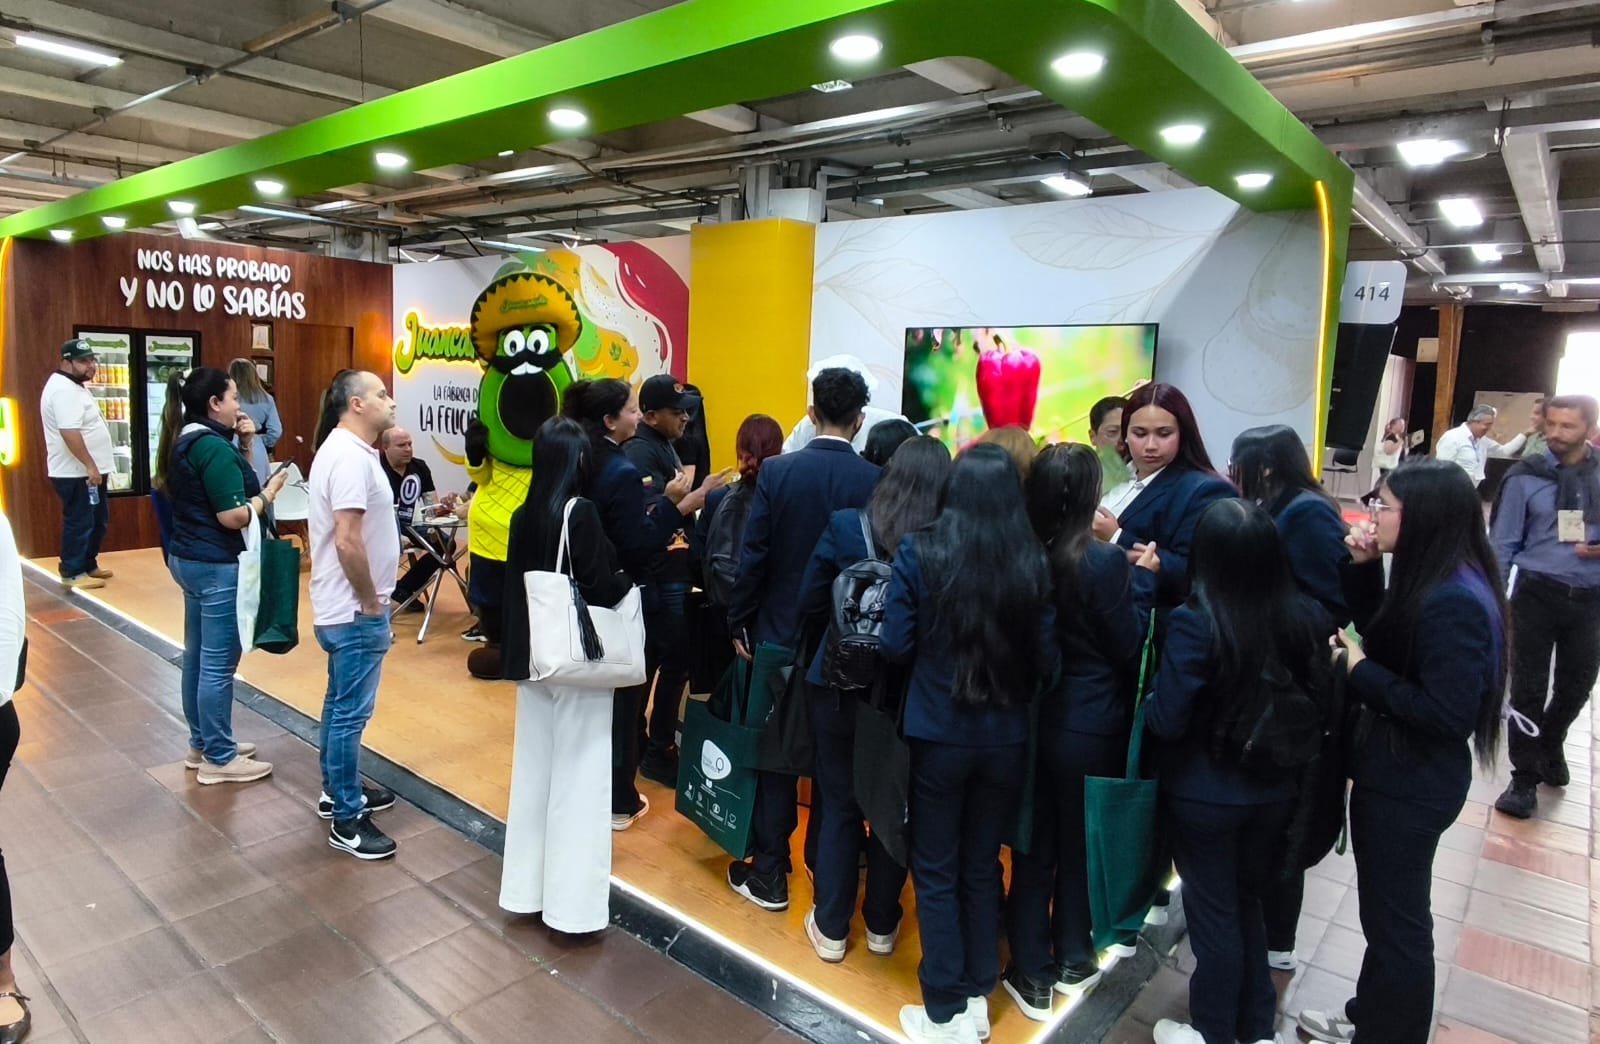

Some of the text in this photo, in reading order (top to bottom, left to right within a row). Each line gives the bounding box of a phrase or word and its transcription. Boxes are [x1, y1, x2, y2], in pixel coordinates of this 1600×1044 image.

[137, 248, 291, 284] NOS HAS PROBADO
[119, 276, 306, 319] Y NO LO SABÍAS
[1354, 286, 1390, 301] 414
[395, 312, 476, 372] Juanca
[433, 381, 479, 403] LA FÁBRICA D
[420, 403, 433, 432] LA
